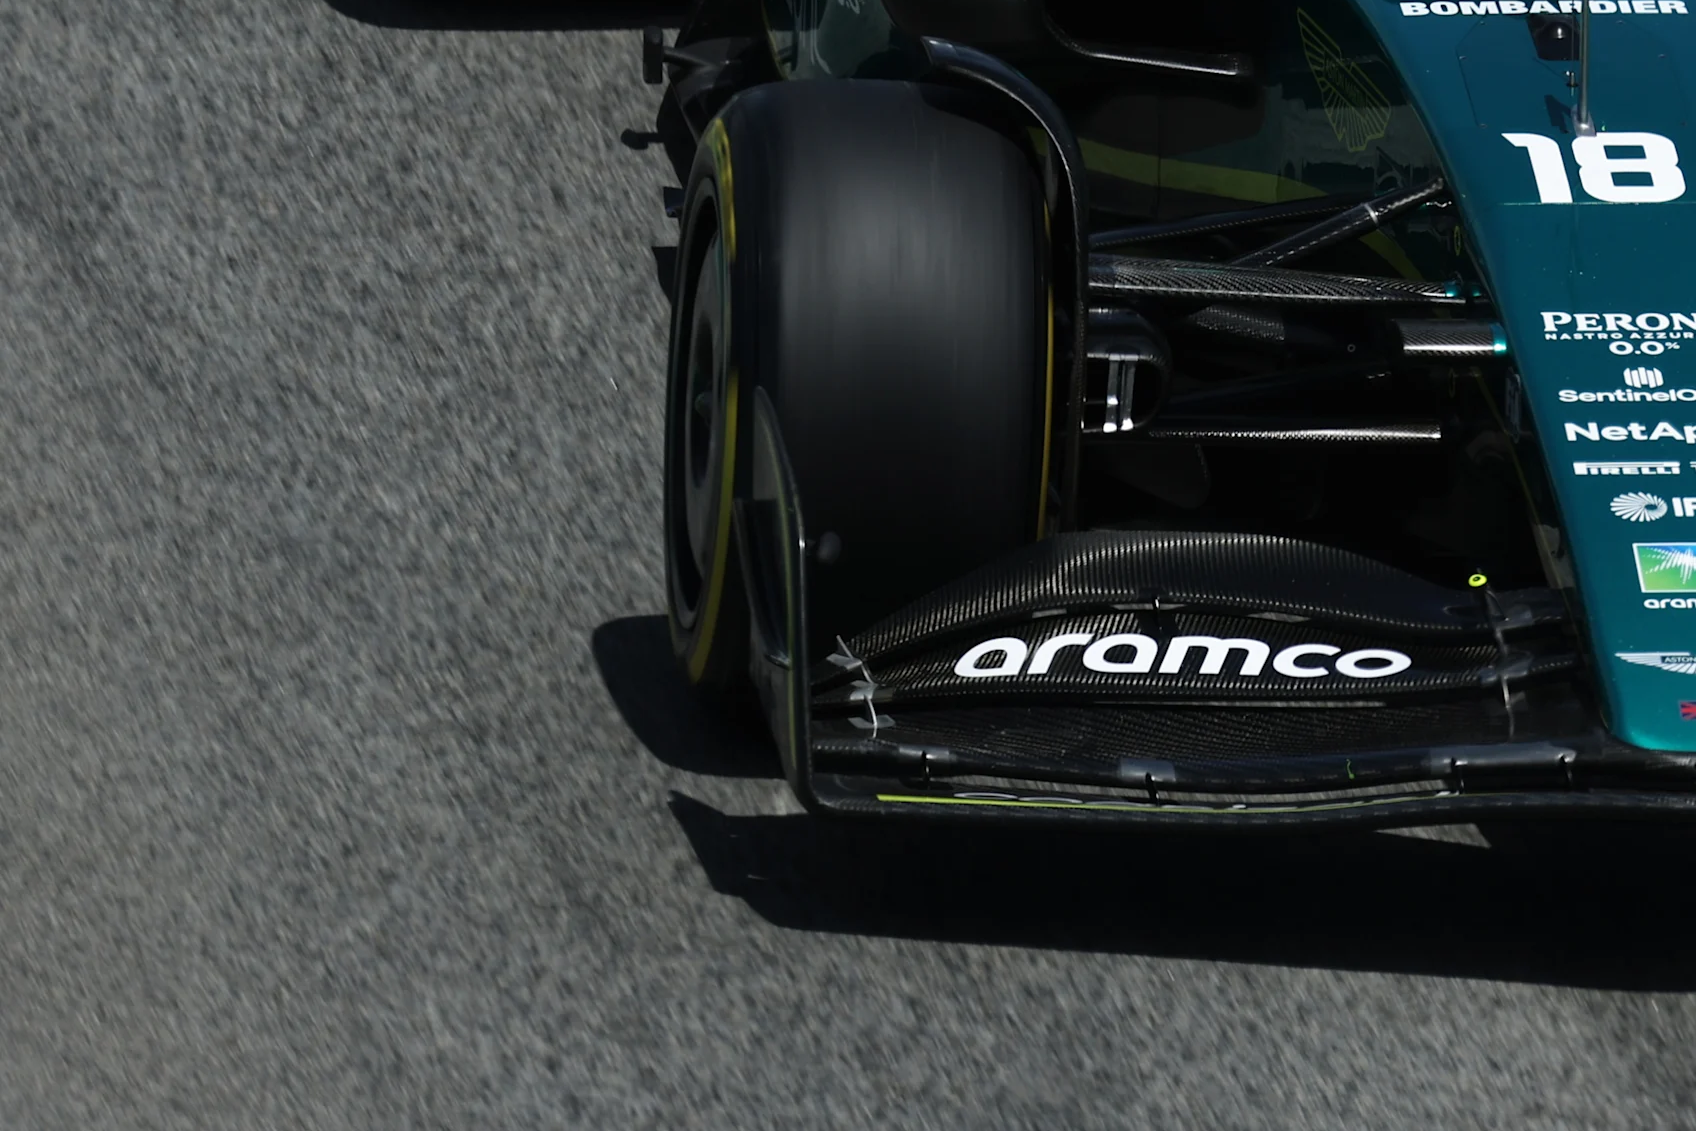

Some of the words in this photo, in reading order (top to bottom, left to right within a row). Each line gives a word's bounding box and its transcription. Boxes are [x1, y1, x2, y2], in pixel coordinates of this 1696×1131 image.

[1400, 0, 1689, 17] BOMBARDIER
[1501, 131, 1687, 203] 18
[1544, 332, 1624, 340] NASTRO
[1608, 341, 1681, 356] 0.0%
[1572, 461, 1681, 475] PIRELLI
[954, 632, 1412, 678] aramco
